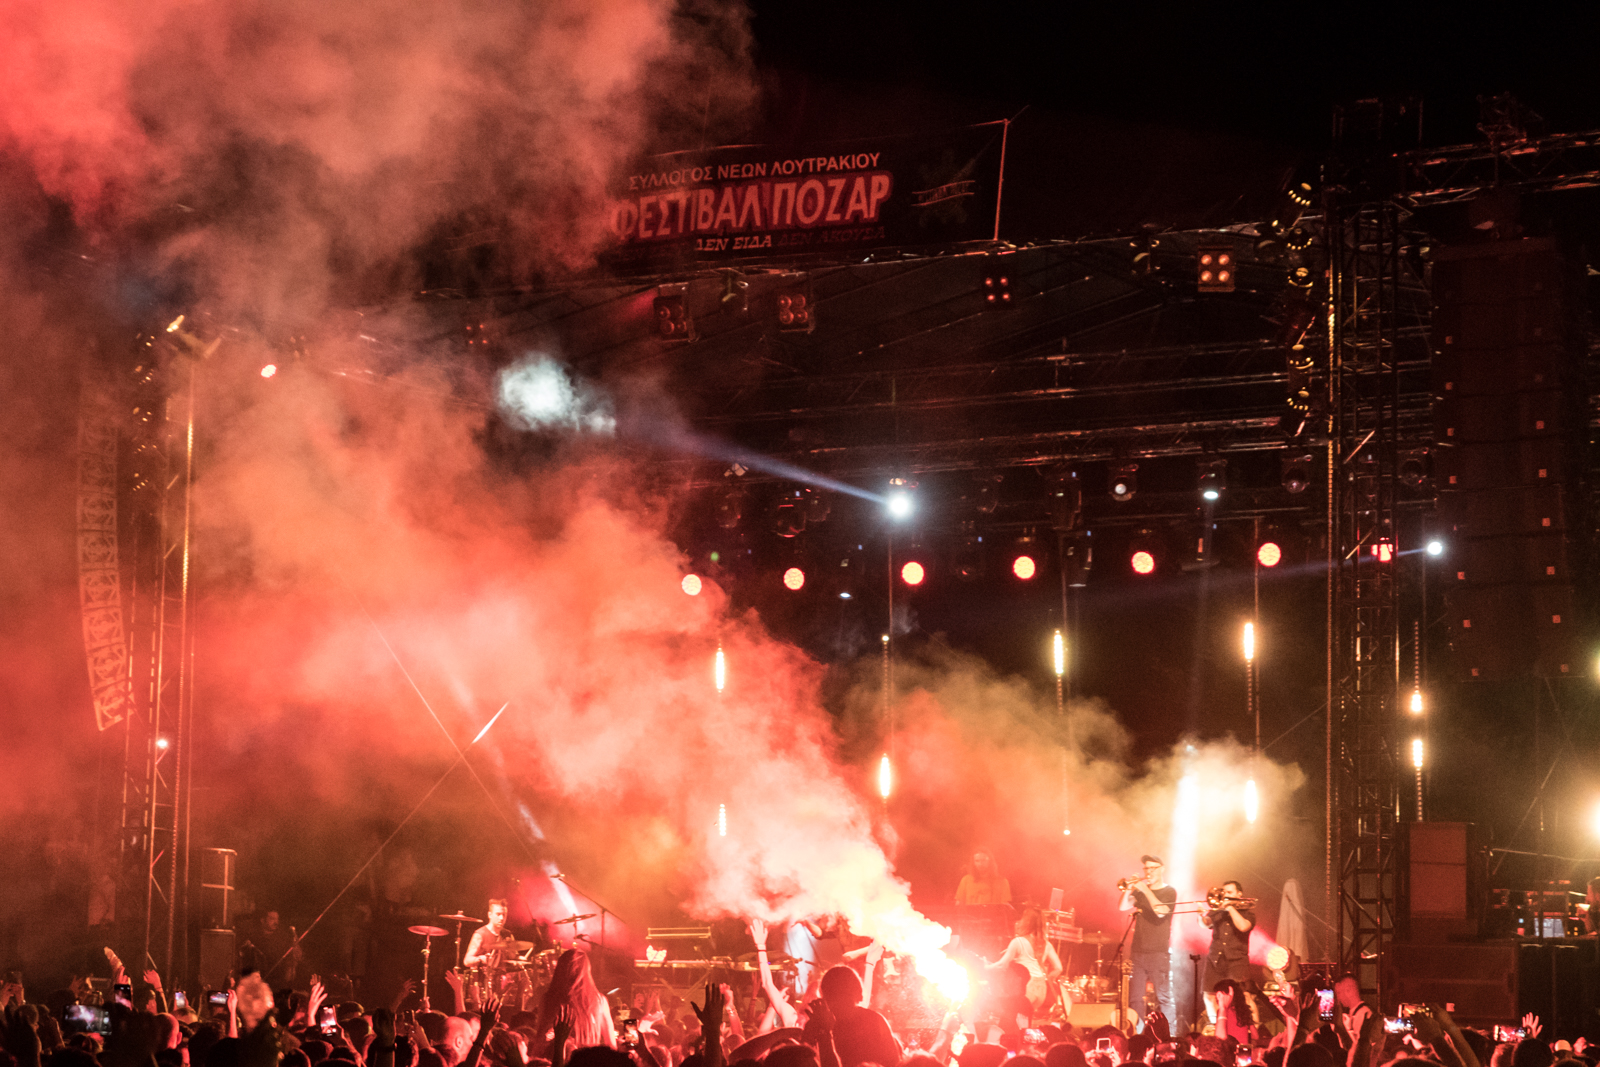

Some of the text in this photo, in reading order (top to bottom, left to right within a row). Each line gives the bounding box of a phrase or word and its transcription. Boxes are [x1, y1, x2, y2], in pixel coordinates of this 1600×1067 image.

[629, 152, 880, 190] ΣΥΛΛΟΓΟΣ ΝΕΩΝ ΛΟΥΤΡΑΚΙΟΥ
[609, 174, 890, 240] ΦΕΣΤΙΒΑΛ ΠΟΖΑΡ
[732, 234, 772, 250] ΕΙΔΑ
